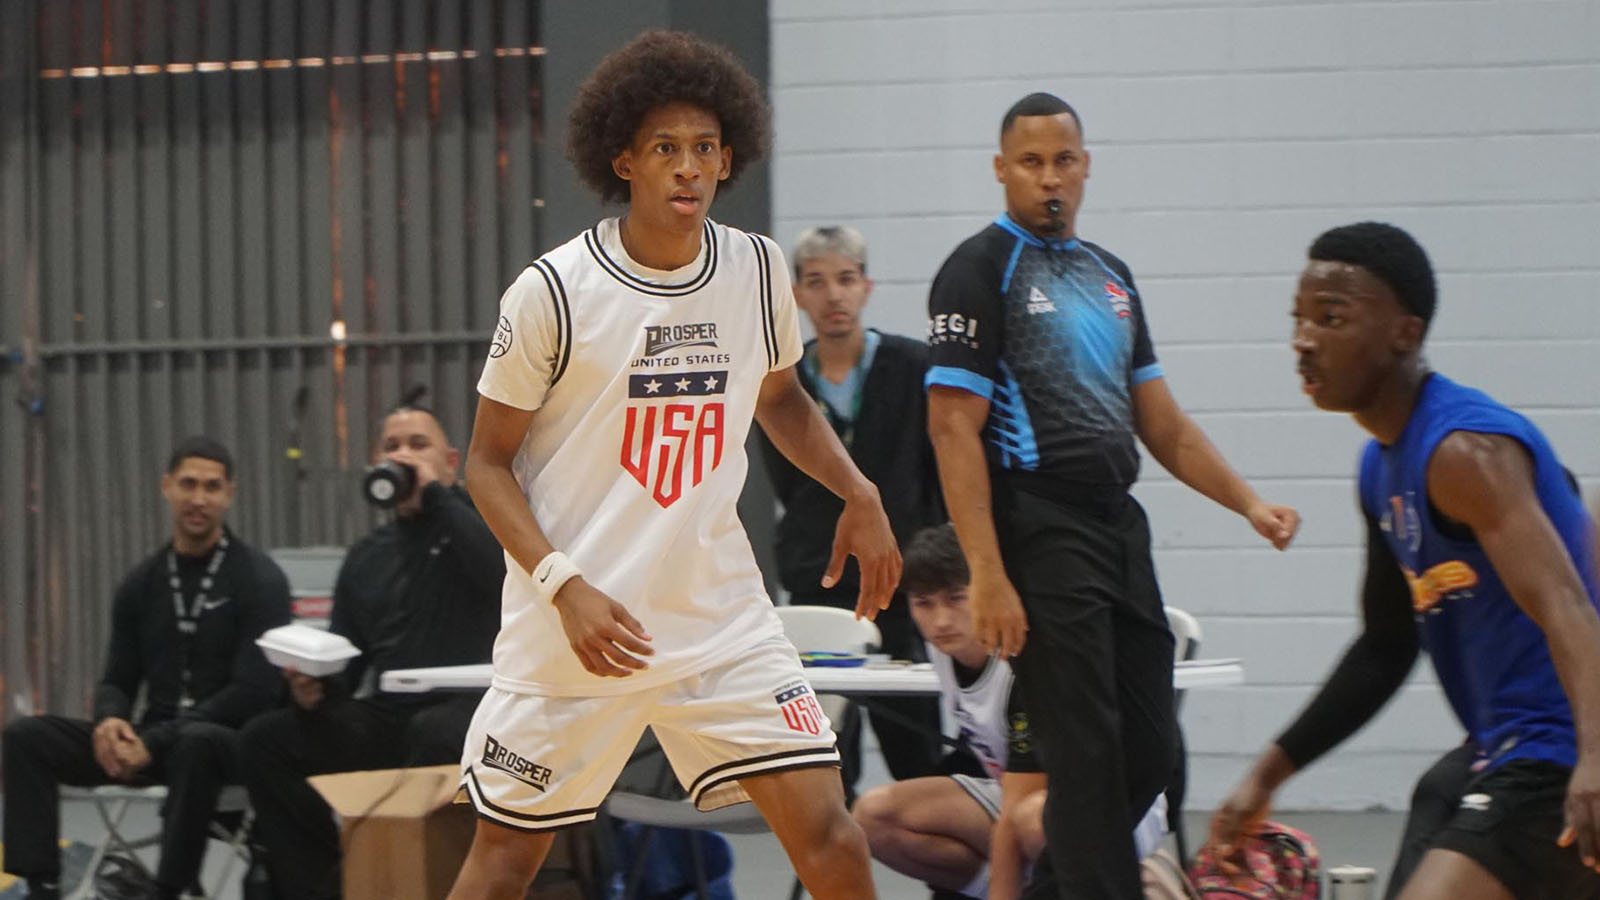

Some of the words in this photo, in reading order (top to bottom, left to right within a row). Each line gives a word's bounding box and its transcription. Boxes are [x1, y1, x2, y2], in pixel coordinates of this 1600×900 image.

[645, 323, 718, 356] PROSPER
[631, 356, 679, 367] UNITED
[686, 354, 730, 364] STATES
[620, 403, 724, 509] USA
[781, 696, 822, 735] USA
[481, 733, 552, 785] PROSPER
